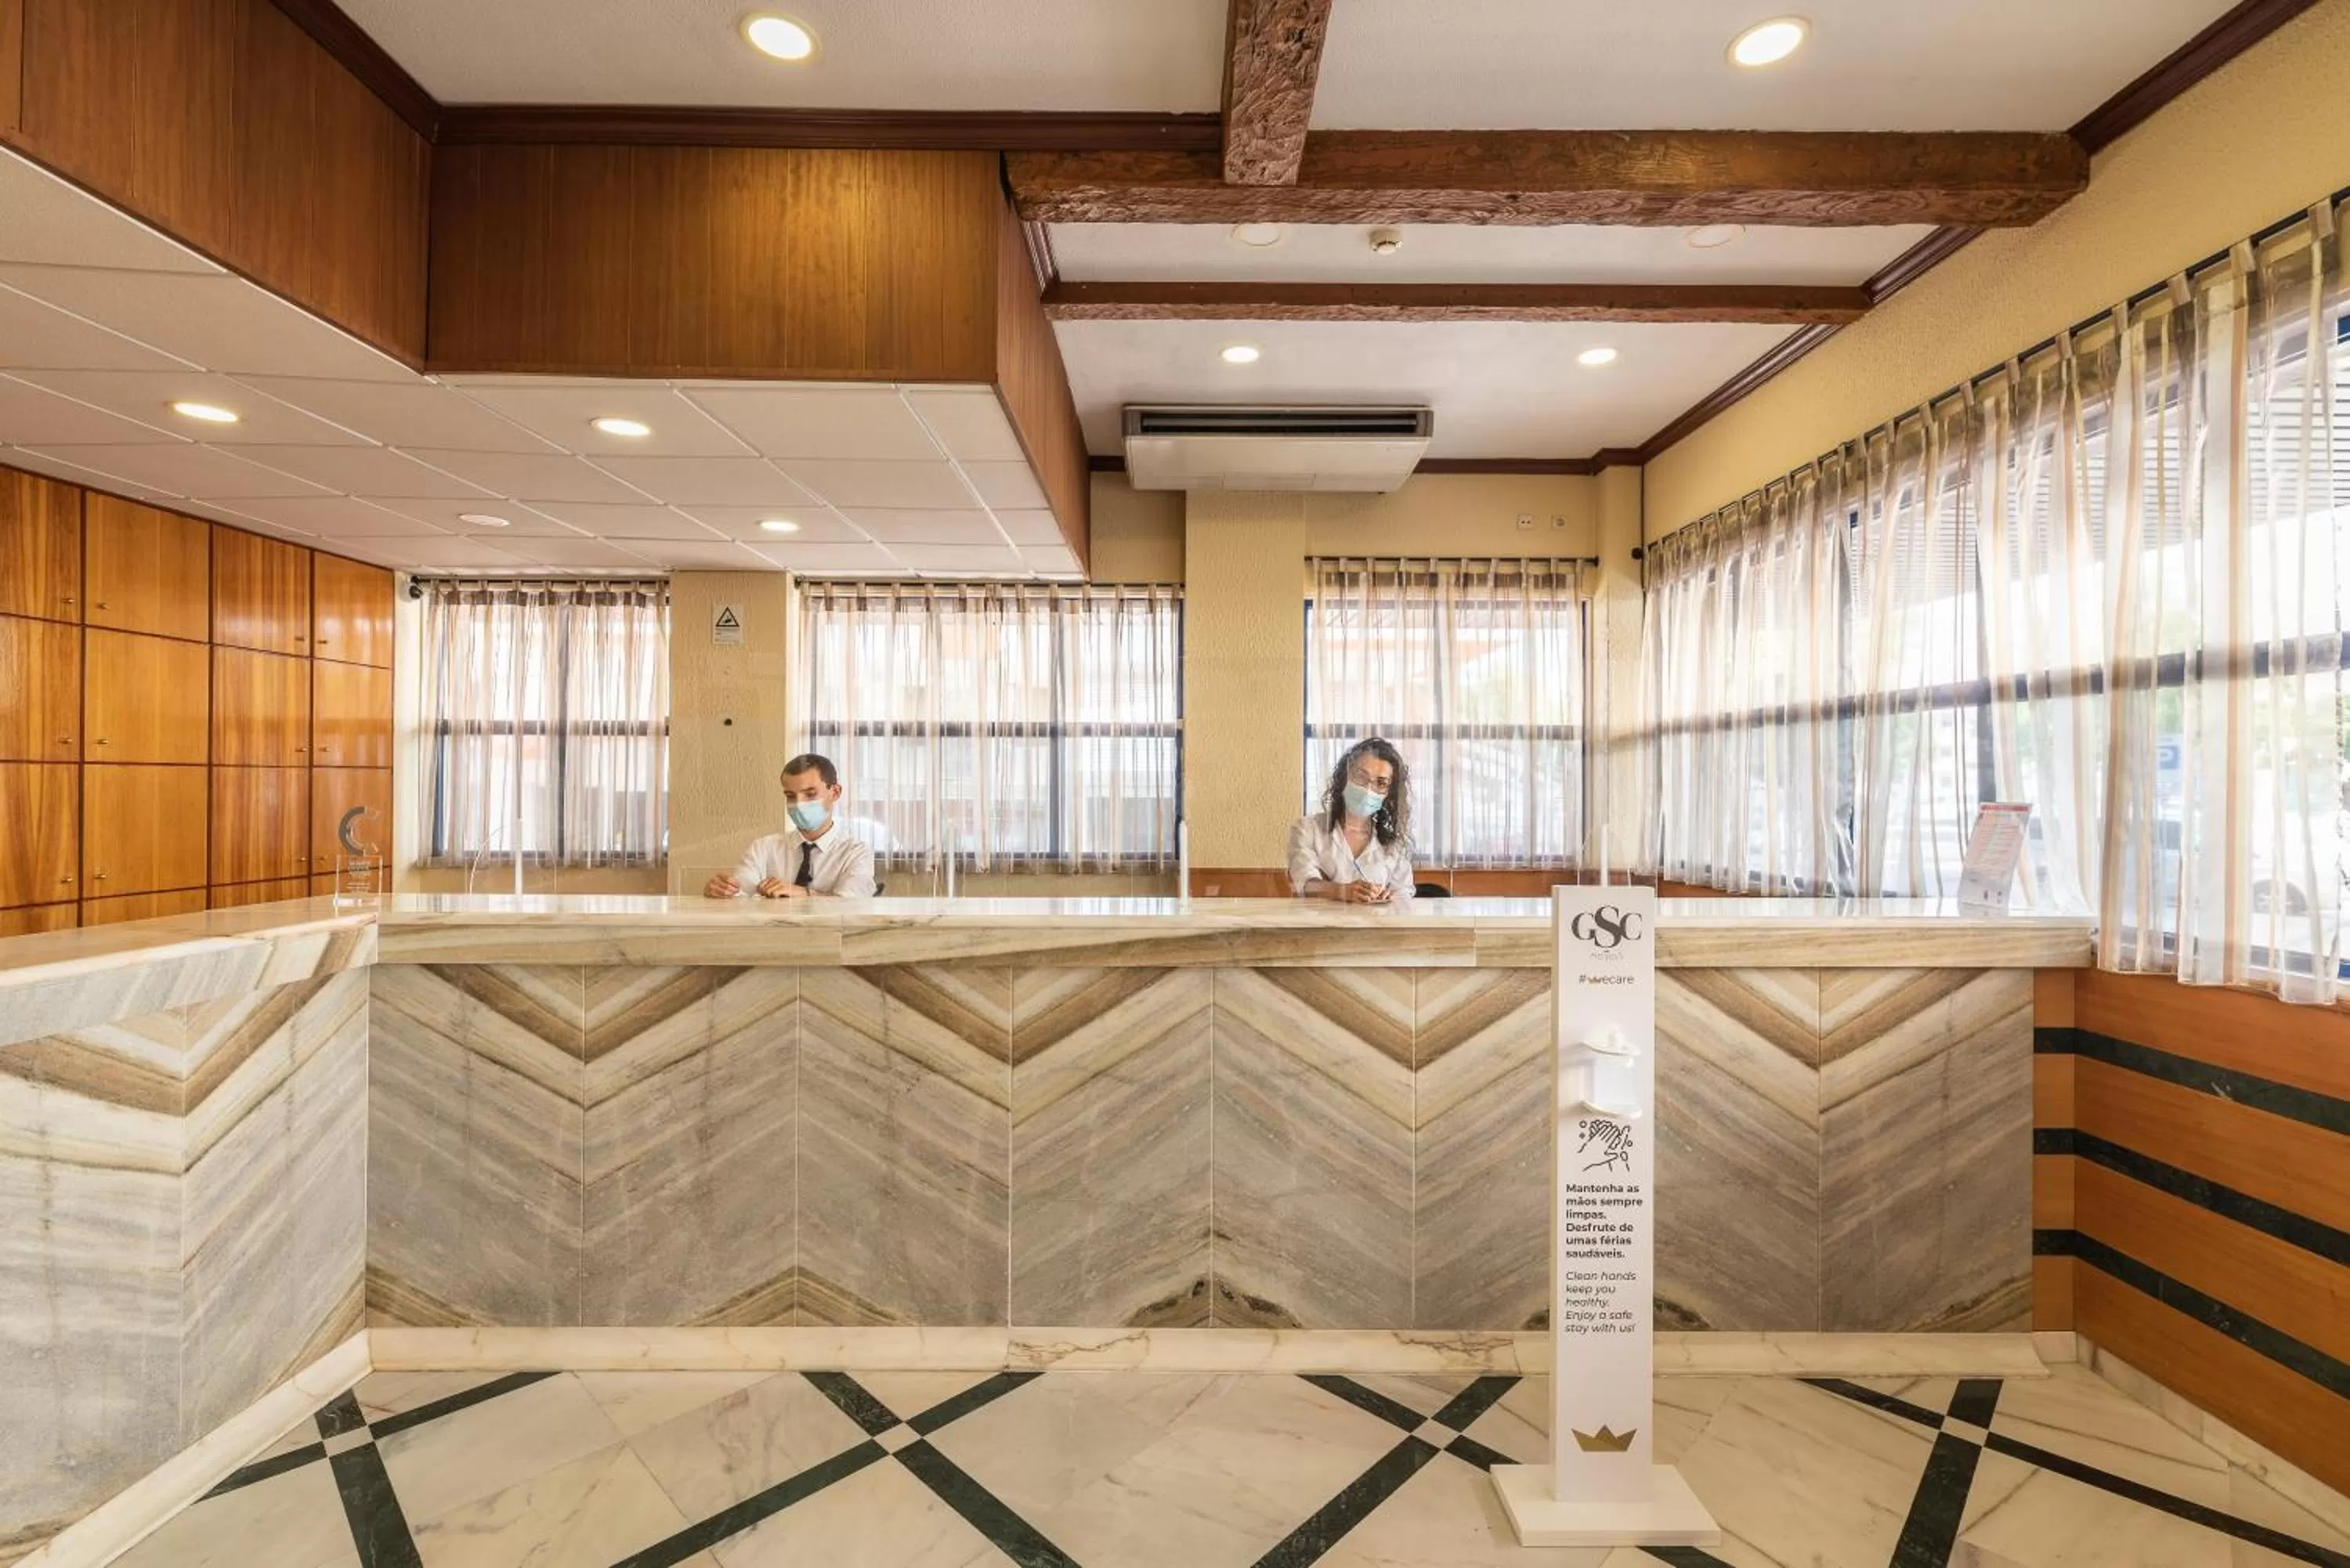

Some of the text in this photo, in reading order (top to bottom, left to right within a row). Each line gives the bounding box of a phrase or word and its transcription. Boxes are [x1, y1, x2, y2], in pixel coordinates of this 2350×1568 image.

[1571, 905, 1642, 948] GSC
[1579, 974, 1634, 984] #wecare
[1566, 1197, 1643, 1208] mãos sempre
[1566, 1209, 1606, 1219] limpas.
[1600, 1236, 1632, 1245] férias
[1566, 1248, 1625, 1258] saudáveis.
[1566, 1271, 1636, 1281] Clean hands
[1566, 1284, 1615, 1295] keep you
[1566, 1310, 1596, 1321] Enjoy
[1610, 1310, 1632, 1319] safe
[1566, 1325, 1589, 1334] stay
[1592, 1324, 1616, 1332] with
